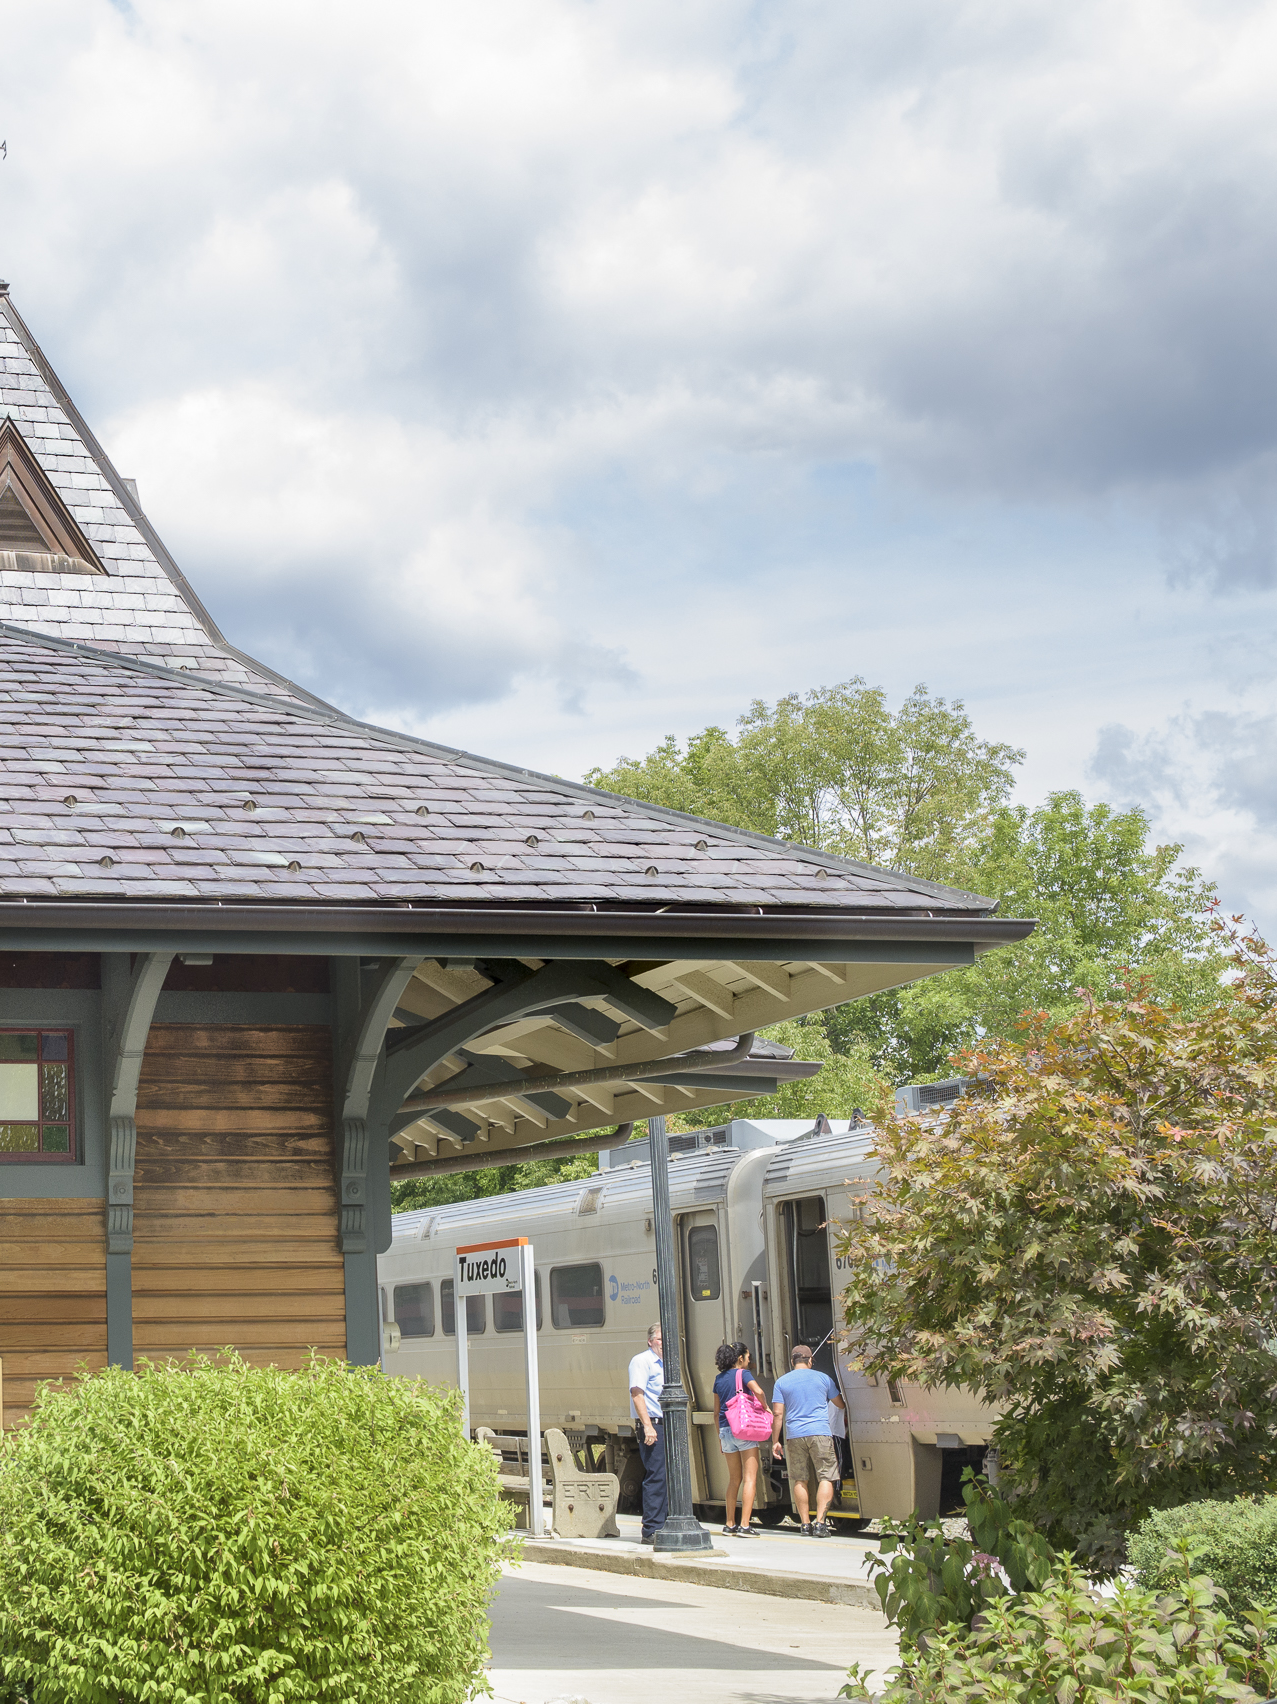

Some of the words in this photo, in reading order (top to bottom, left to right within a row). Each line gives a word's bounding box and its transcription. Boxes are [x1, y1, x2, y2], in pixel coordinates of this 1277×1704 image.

[459, 1252, 506, 1282] Tuxedo
[620, 1281, 650, 1292] Metro-North
[621, 1294, 641, 1304] Railroad
[562, 1483, 610, 1500] ERIE
